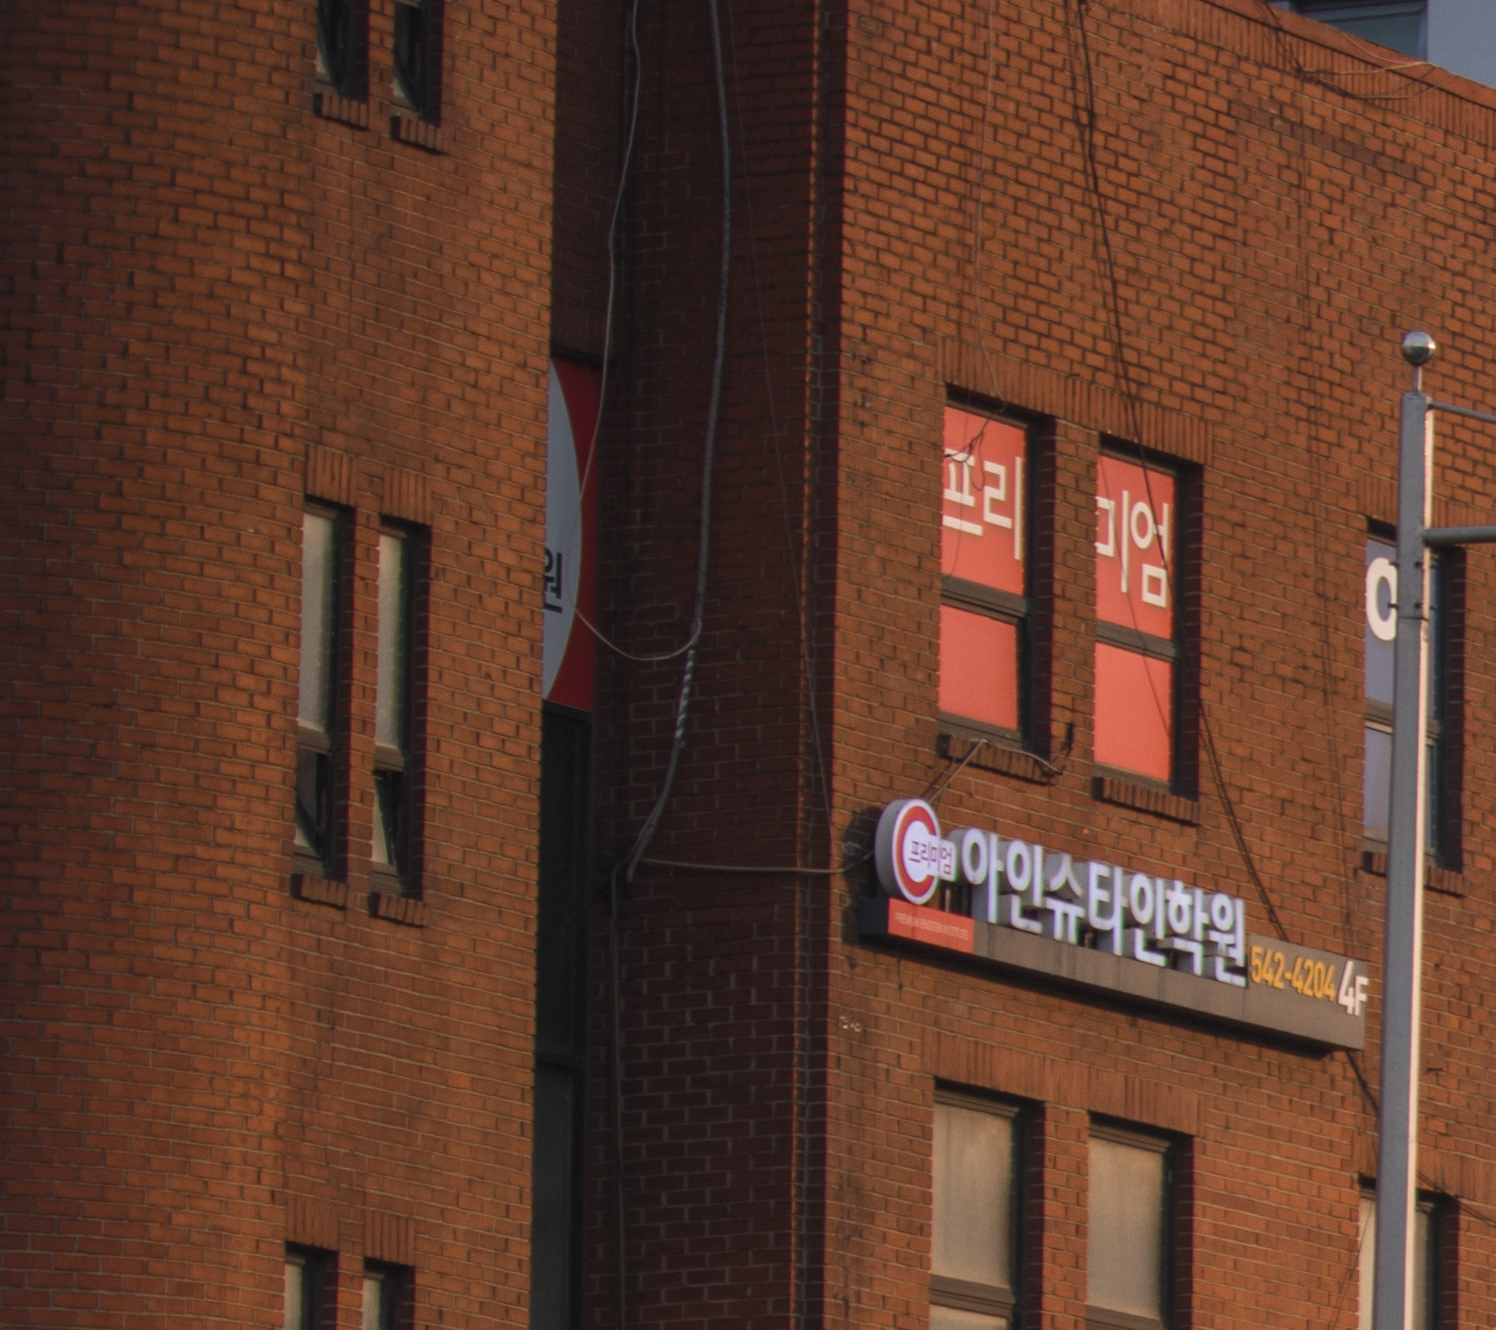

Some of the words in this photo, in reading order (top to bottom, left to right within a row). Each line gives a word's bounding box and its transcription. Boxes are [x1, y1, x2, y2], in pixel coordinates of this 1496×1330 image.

[909, 840, 952, 876] 프리미엄
[961, 826, 1248, 988] 아인슈타인학원
[1250, 944, 1337, 1003] 542-4204
[1338, 960, 1369, 1016] 4F
